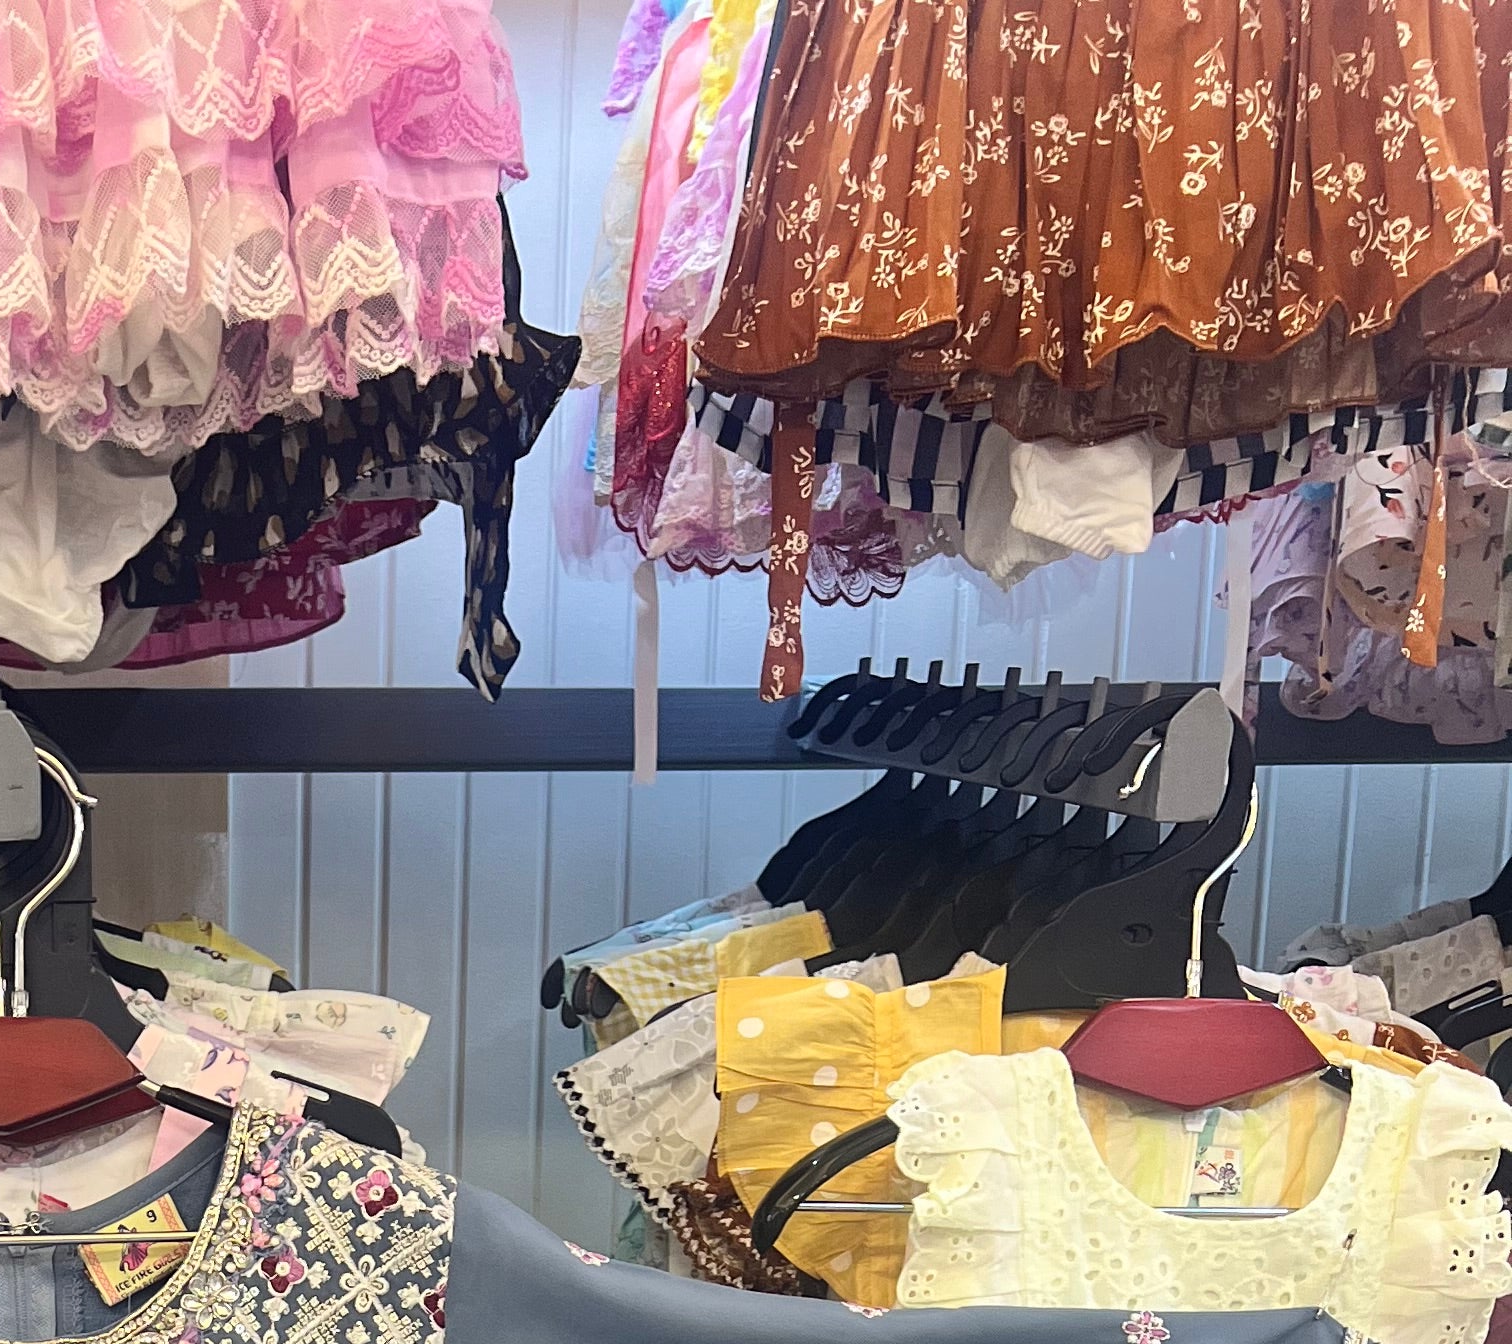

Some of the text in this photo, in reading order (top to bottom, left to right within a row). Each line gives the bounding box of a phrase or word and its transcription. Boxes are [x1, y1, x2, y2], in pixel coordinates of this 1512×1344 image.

[146, 1209, 157, 1223] 9
[114, 1279, 132, 1293] ICE
[131, 1267, 154, 1285] FIRE
